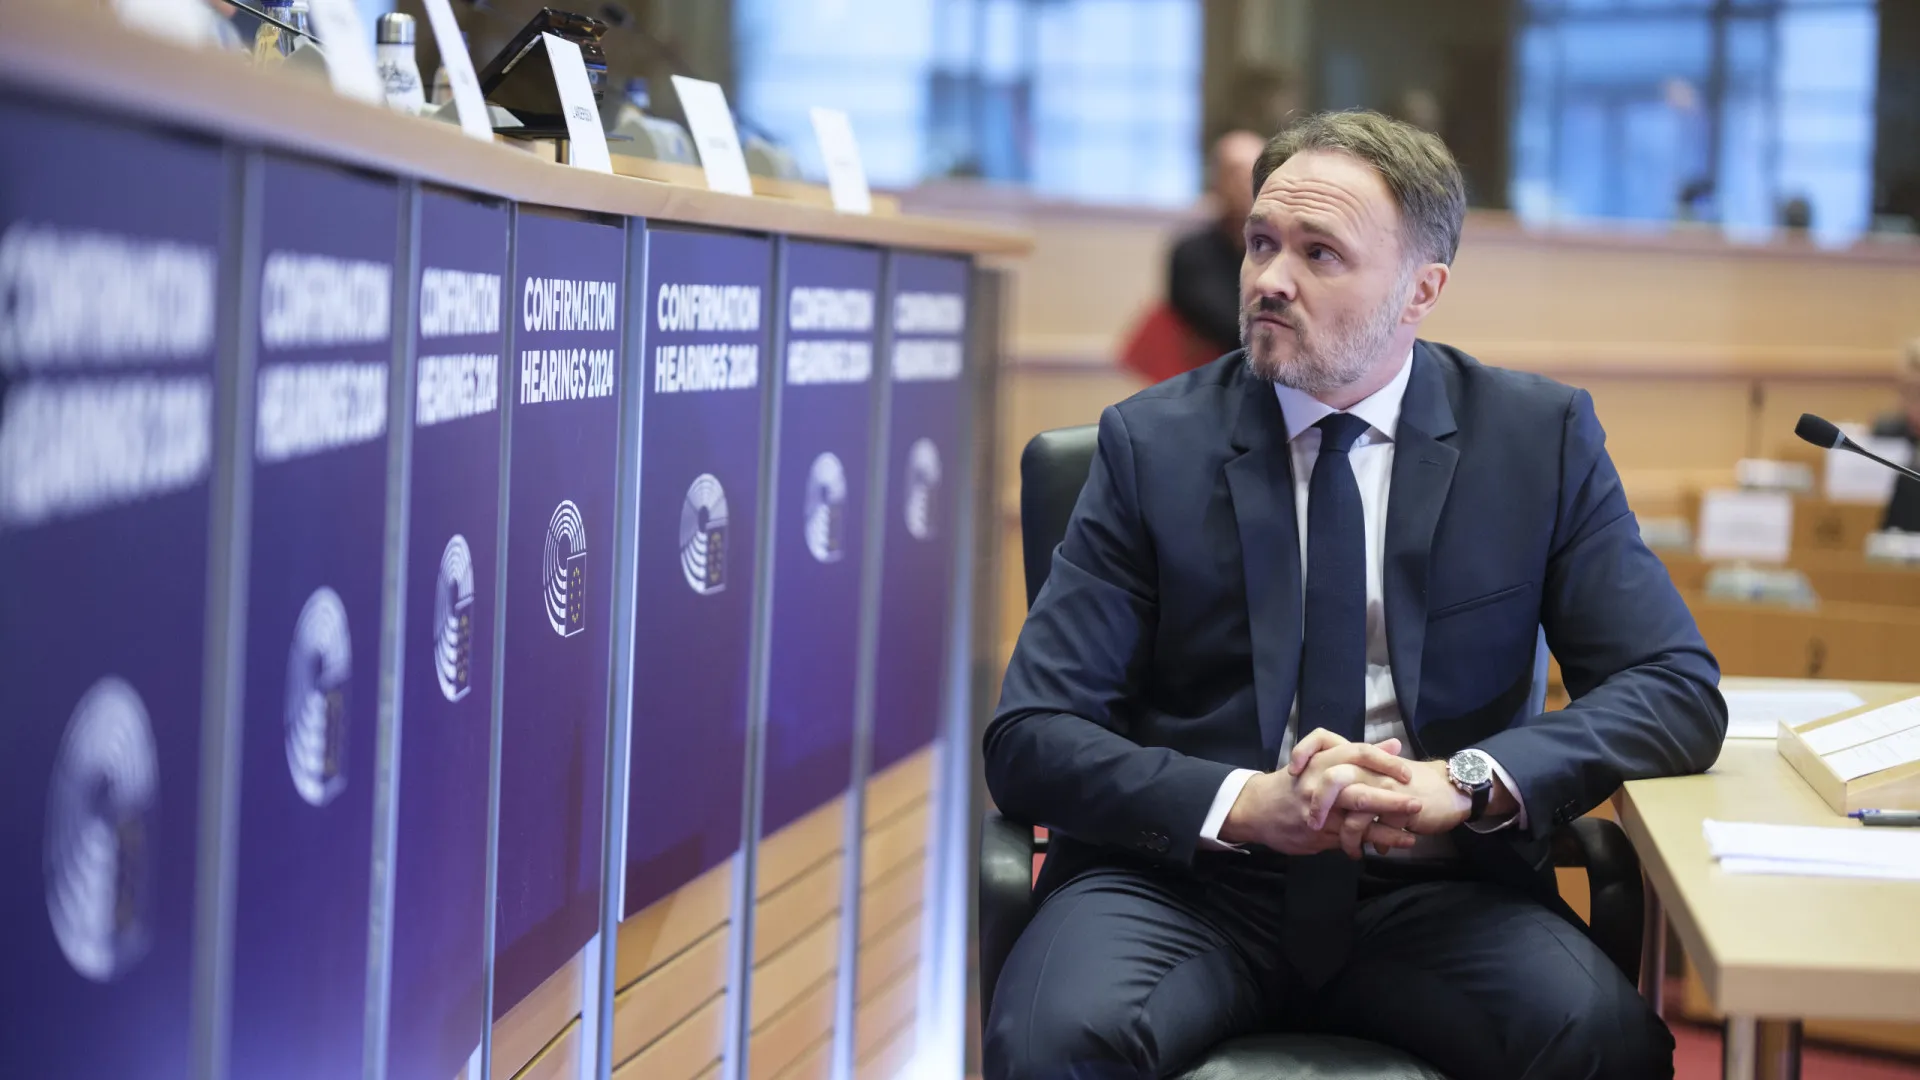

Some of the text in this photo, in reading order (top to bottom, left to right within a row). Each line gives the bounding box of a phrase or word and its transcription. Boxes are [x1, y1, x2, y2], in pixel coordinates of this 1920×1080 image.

[523, 276, 616, 332] CONFIRMATION
[657, 283, 761, 332] CONFIRMATION
[520, 348, 614, 404] HEARINGS 2024
[654, 343, 729, 393] HEARINGS
